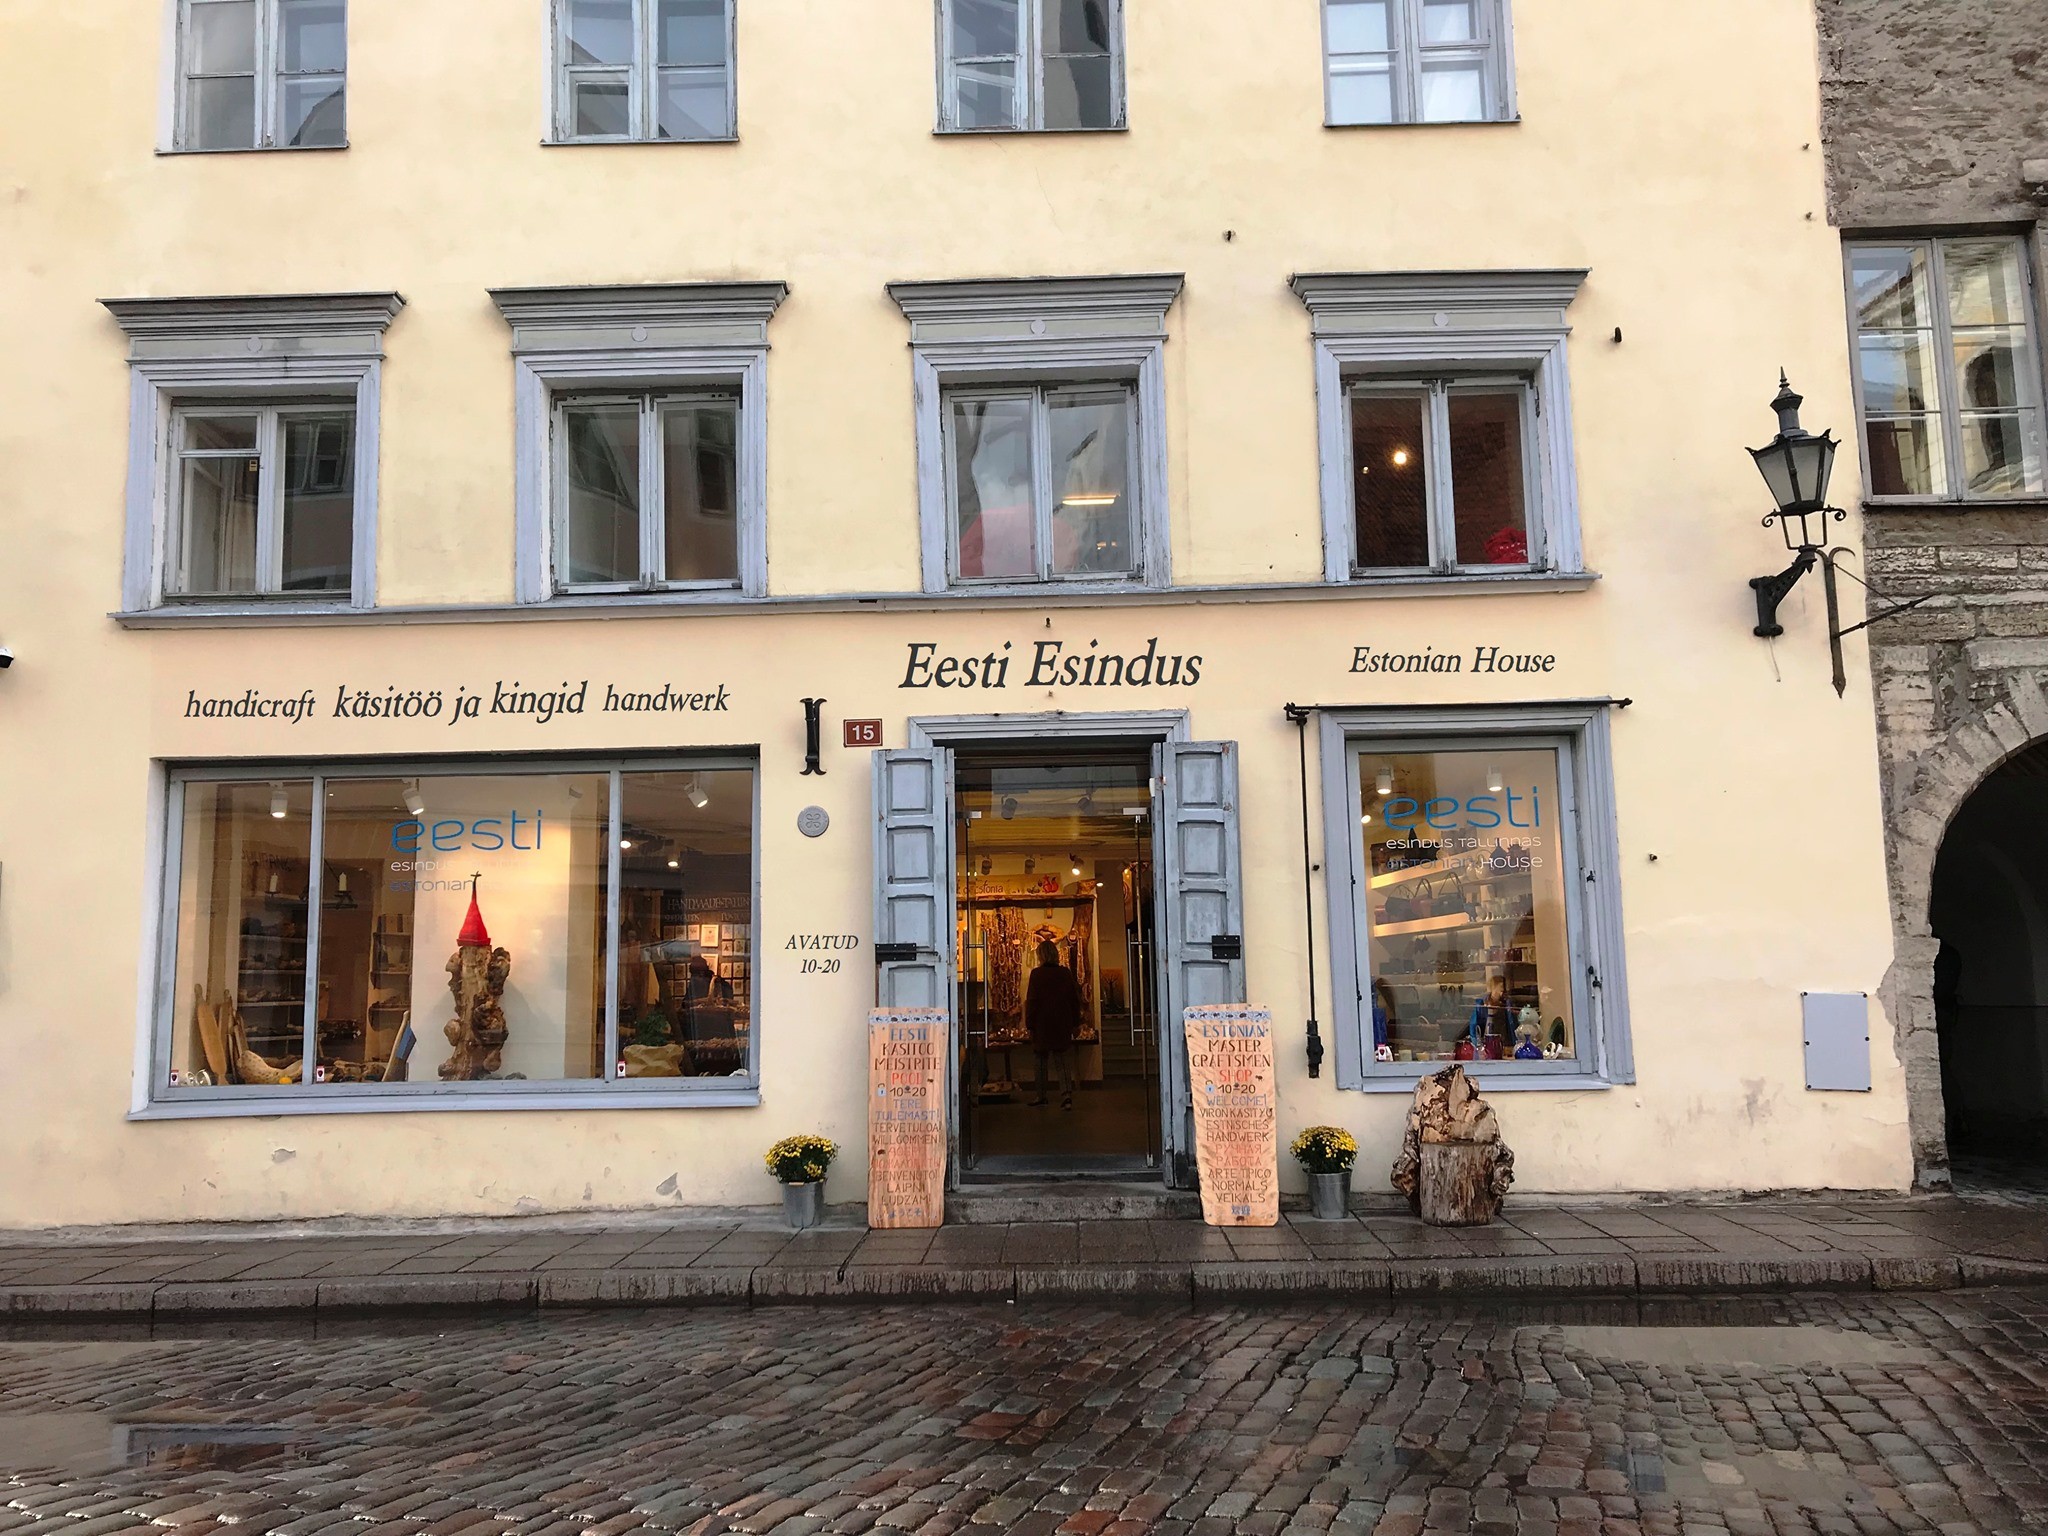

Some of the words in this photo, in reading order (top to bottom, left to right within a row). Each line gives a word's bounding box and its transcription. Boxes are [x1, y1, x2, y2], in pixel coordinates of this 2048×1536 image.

[898, 640, 1011, 688] Eesti
[1024, 637, 1203, 687] Esindus
[1349, 645, 1461, 673] Estonian
[1470, 646, 1555, 673] House
[184, 690, 315, 724] handicraft
[333, 685, 441, 718] käsitöö
[449, 686, 481, 725] ja
[489, 680, 587, 723] kingid
[603, 684, 729, 712] handwerk
[852, 725, 874, 741] 15
[1383, 786, 1540, 830] eesti
[391, 809, 542, 853] eesti
[785, 934, 859, 950] AVATUD
[800, 958, 840, 974] 10-20
[890, 1027, 927, 1041] EESTI
[1202, 1024, 1265, 1038] ESTONIAN
[1208, 1039, 1261, 1053] MASTER
[874, 1057, 941, 1071] MEISTRITE
[1192, 1054, 1271, 1067] CRAFTSMEN
[1219, 1069, 1253, 1082] SHOP
[893, 1098, 921, 1109] TERE
[1206, 1093, 1267, 1106] WELCOME!
[1206, 1119, 1269, 1130] ESTNISCHES
[1206, 1131, 1269, 1142] HANDWERK
[886, 1183, 926, 1193] LAIPNI
[1215, 1193, 1266, 1203] VEIKALS
